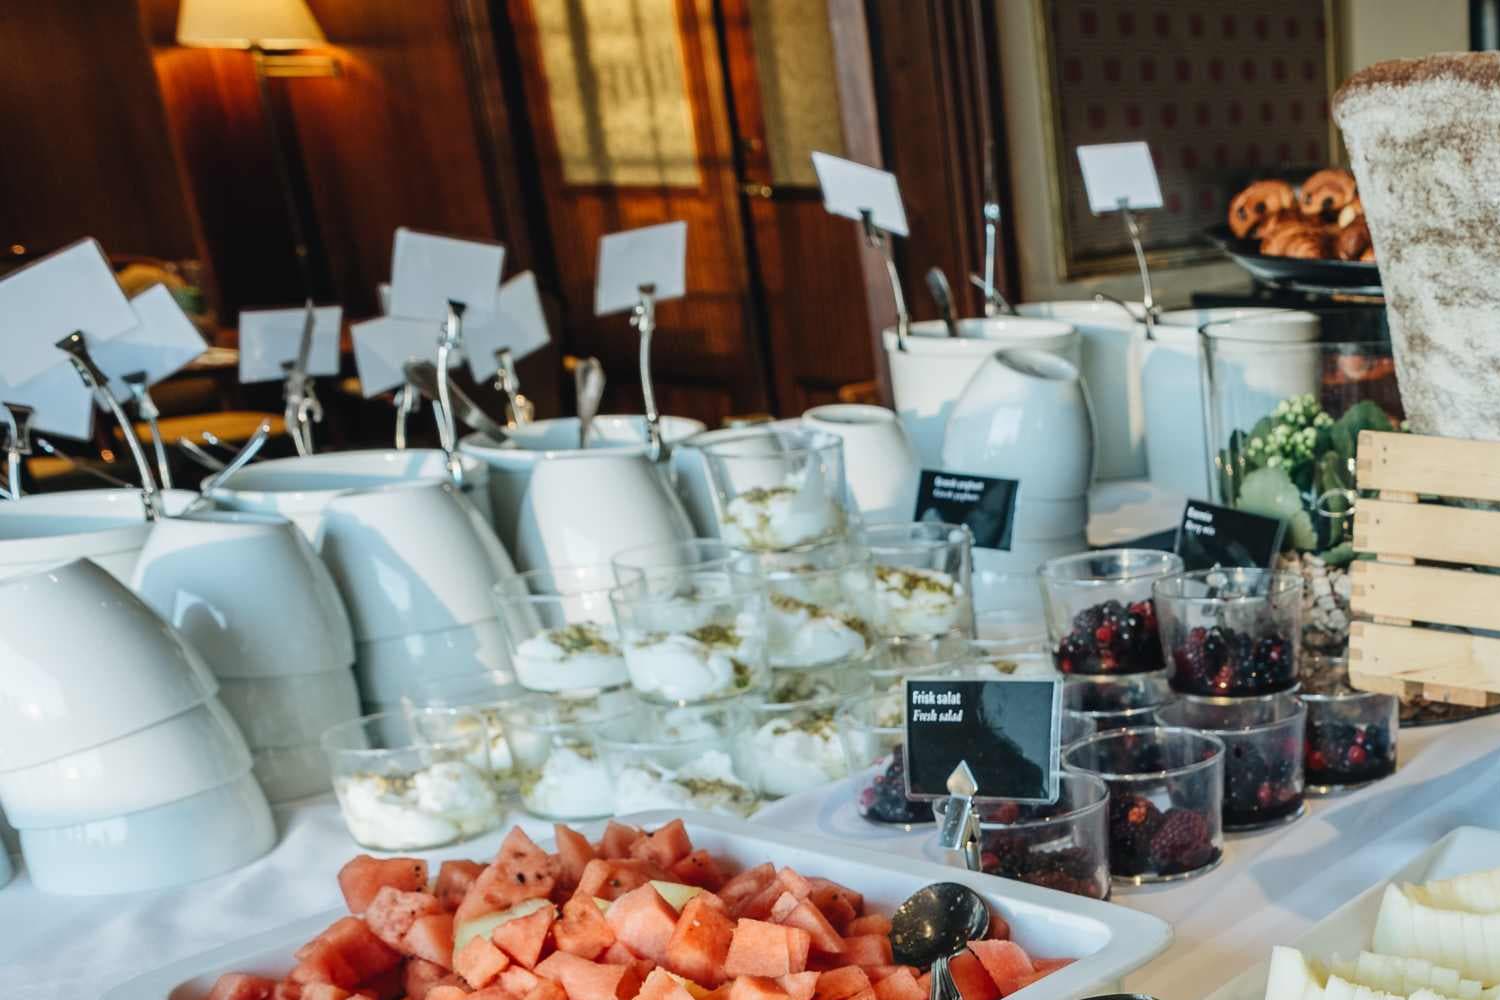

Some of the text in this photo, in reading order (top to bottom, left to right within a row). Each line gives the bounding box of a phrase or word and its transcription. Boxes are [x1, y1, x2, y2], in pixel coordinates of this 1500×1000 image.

[912, 690, 961, 705] Frisk salat
[912, 708, 964, 722] Fresh salad
